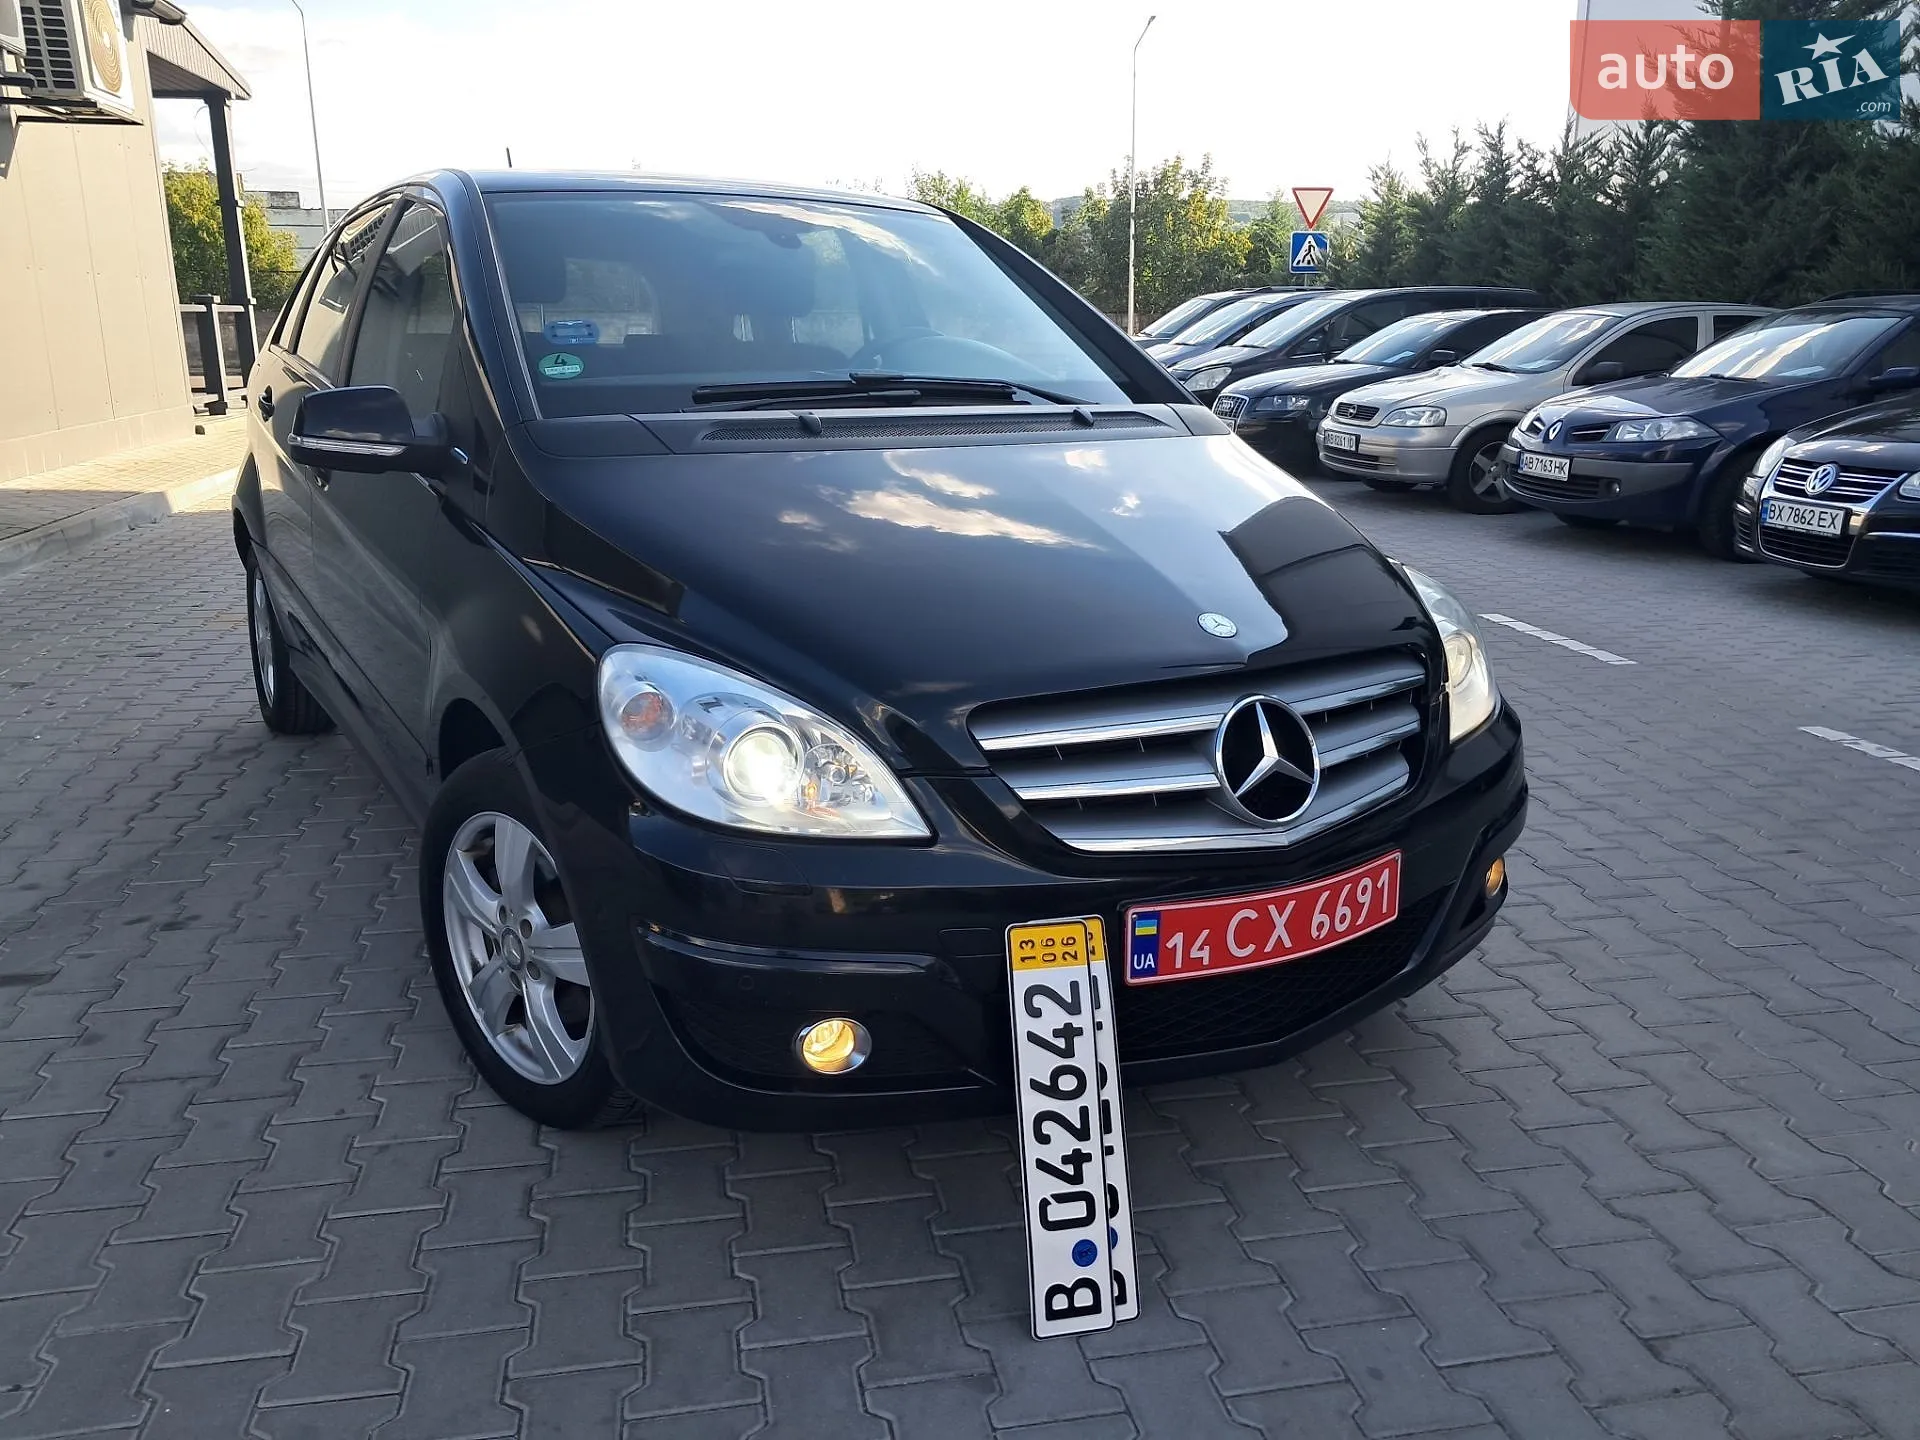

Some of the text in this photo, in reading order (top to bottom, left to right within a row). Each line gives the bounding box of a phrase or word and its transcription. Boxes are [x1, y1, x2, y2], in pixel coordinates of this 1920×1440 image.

[554, 354, 568, 367] 4
[1768, 503, 1785, 521] BX
[1786, 506, 1816, 526] 7862
[1817, 510, 1839, 530] EX
[1165, 929, 1210, 969] 14
[1226, 900, 1296, 958] CX
[1310, 868, 1390, 941] 6691
[1019, 938, 1036, 963] 13
[1041, 937, 1057, 963] 06
[1061, 935, 1078, 961] 26
[1133, 953, 1156, 970] UA
[1023, 980, 1102, 1321] B 042642
